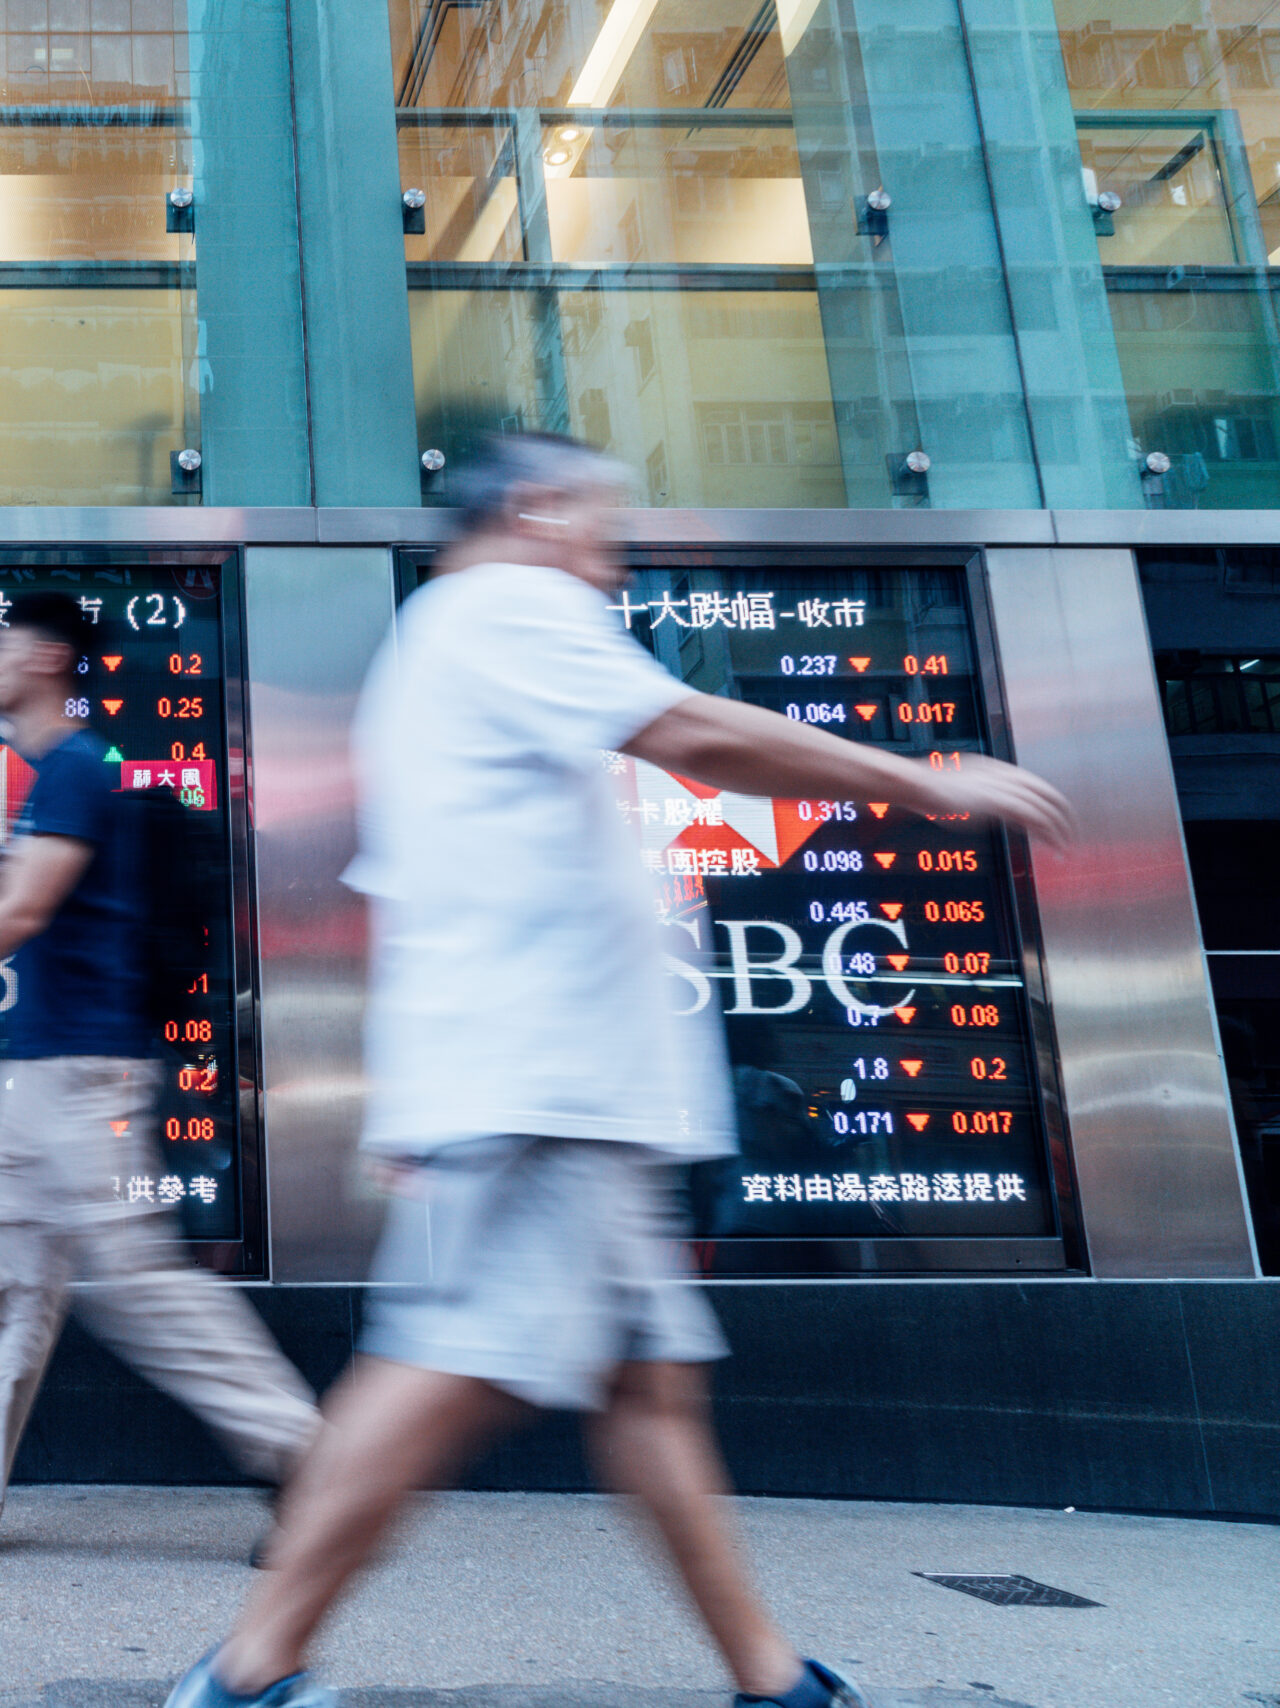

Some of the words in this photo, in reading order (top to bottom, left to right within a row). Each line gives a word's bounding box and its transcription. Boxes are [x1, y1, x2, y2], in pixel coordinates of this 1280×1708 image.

[127, 593, 186, 630] (2)
[170, 654, 202, 674] 0.2
[781, 655, 837, 675] 0.237
[904, 655, 948, 675] 0.41
[158, 697, 203, 718] 0.25
[786, 703, 846, 723] 0.064
[898, 703, 955, 723] 0.017
[172, 742, 206, 761] 0.4
[929, 751, 961, 771] 0.1
[798, 801, 857, 821] 0.315
[804, 850, 863, 871] 0.098
[918, 850, 978, 871] 0.015
[810, 901, 868, 922] 0.445
[924, 901, 985, 922] 0.065
[830, 953, 876, 974] 0.48
[944, 953, 990, 974] 0.07
[847, 1005, 880, 1026] 0.7
[951, 1005, 999, 1026] 0.08
[165, 1020, 212, 1042] 0.08
[853, 1058, 889, 1079] 1.8
[971, 1058, 1007, 1079] 0.2
[166, 1118, 214, 1141] 0.08
[833, 1112, 893, 1134] 0.171
[952, 1112, 1013, 1134] 0.017
[741, 1173, 1026, 1202] 資料由湯森路透提供
